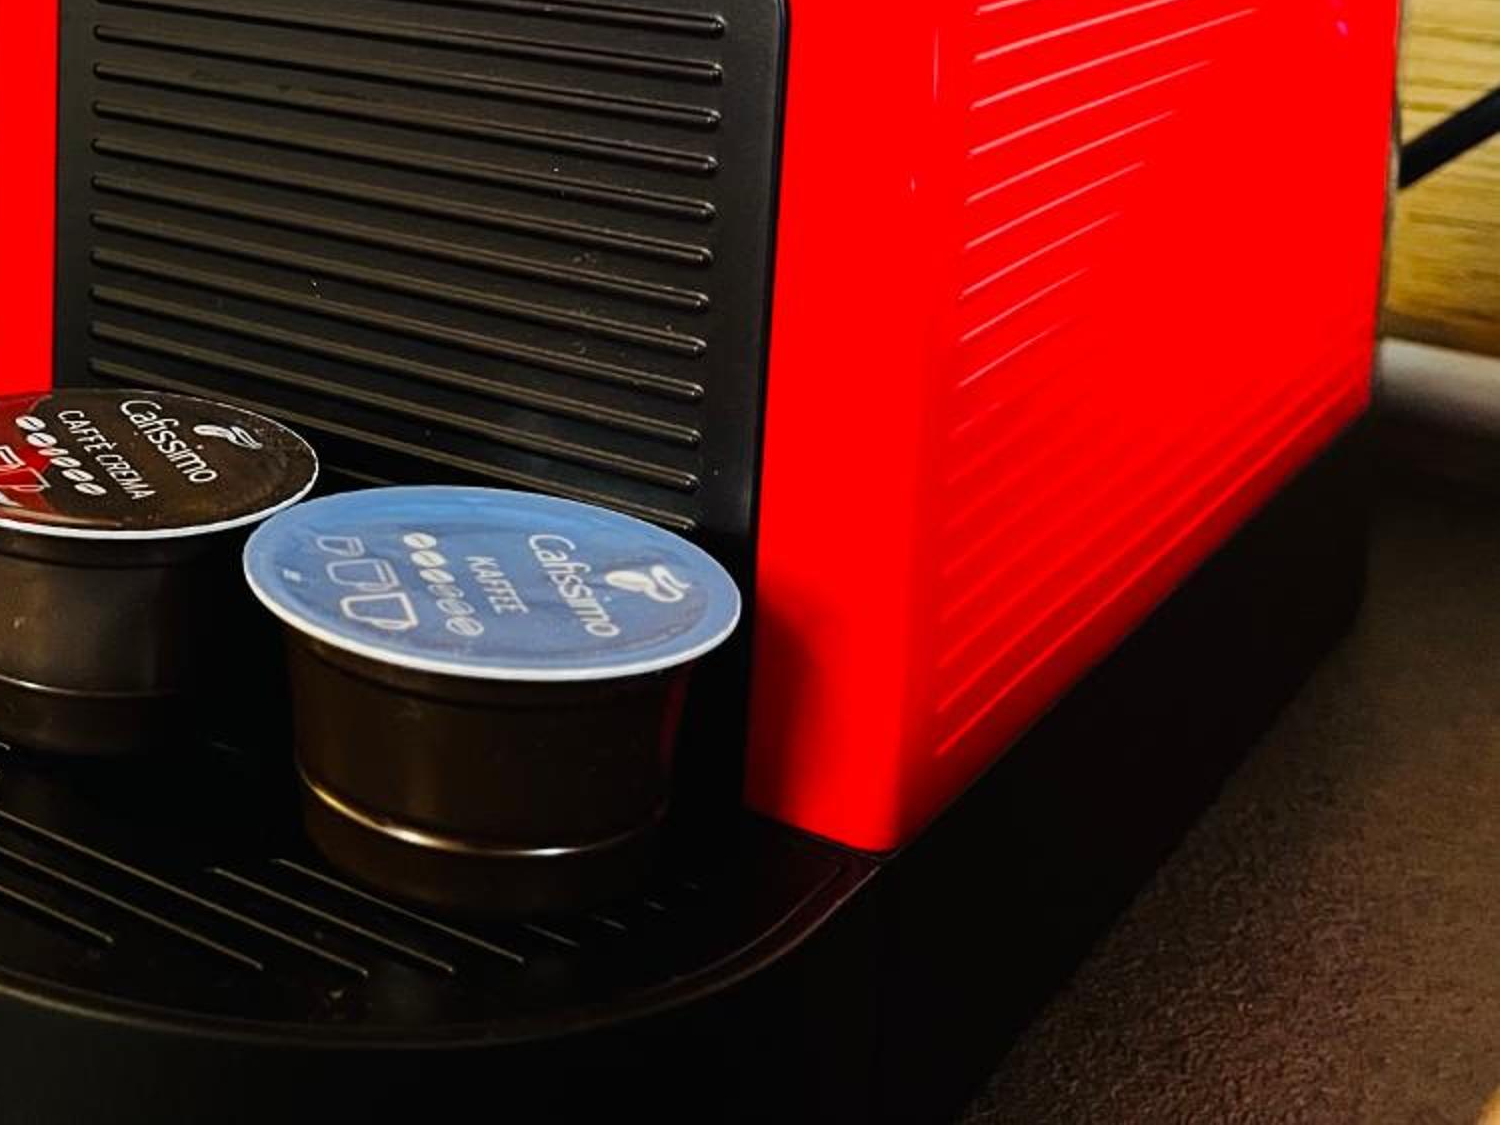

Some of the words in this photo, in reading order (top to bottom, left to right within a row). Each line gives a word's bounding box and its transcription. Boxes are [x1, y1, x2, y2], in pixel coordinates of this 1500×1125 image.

[57, 410, 118, 453] CAFFÈ
[95, 453, 157, 500] CREMA
[120, 400, 219, 484] Cafissimo
[463, 555, 530, 615] KAFFEE
[528, 533, 621, 638] Cafissimo
